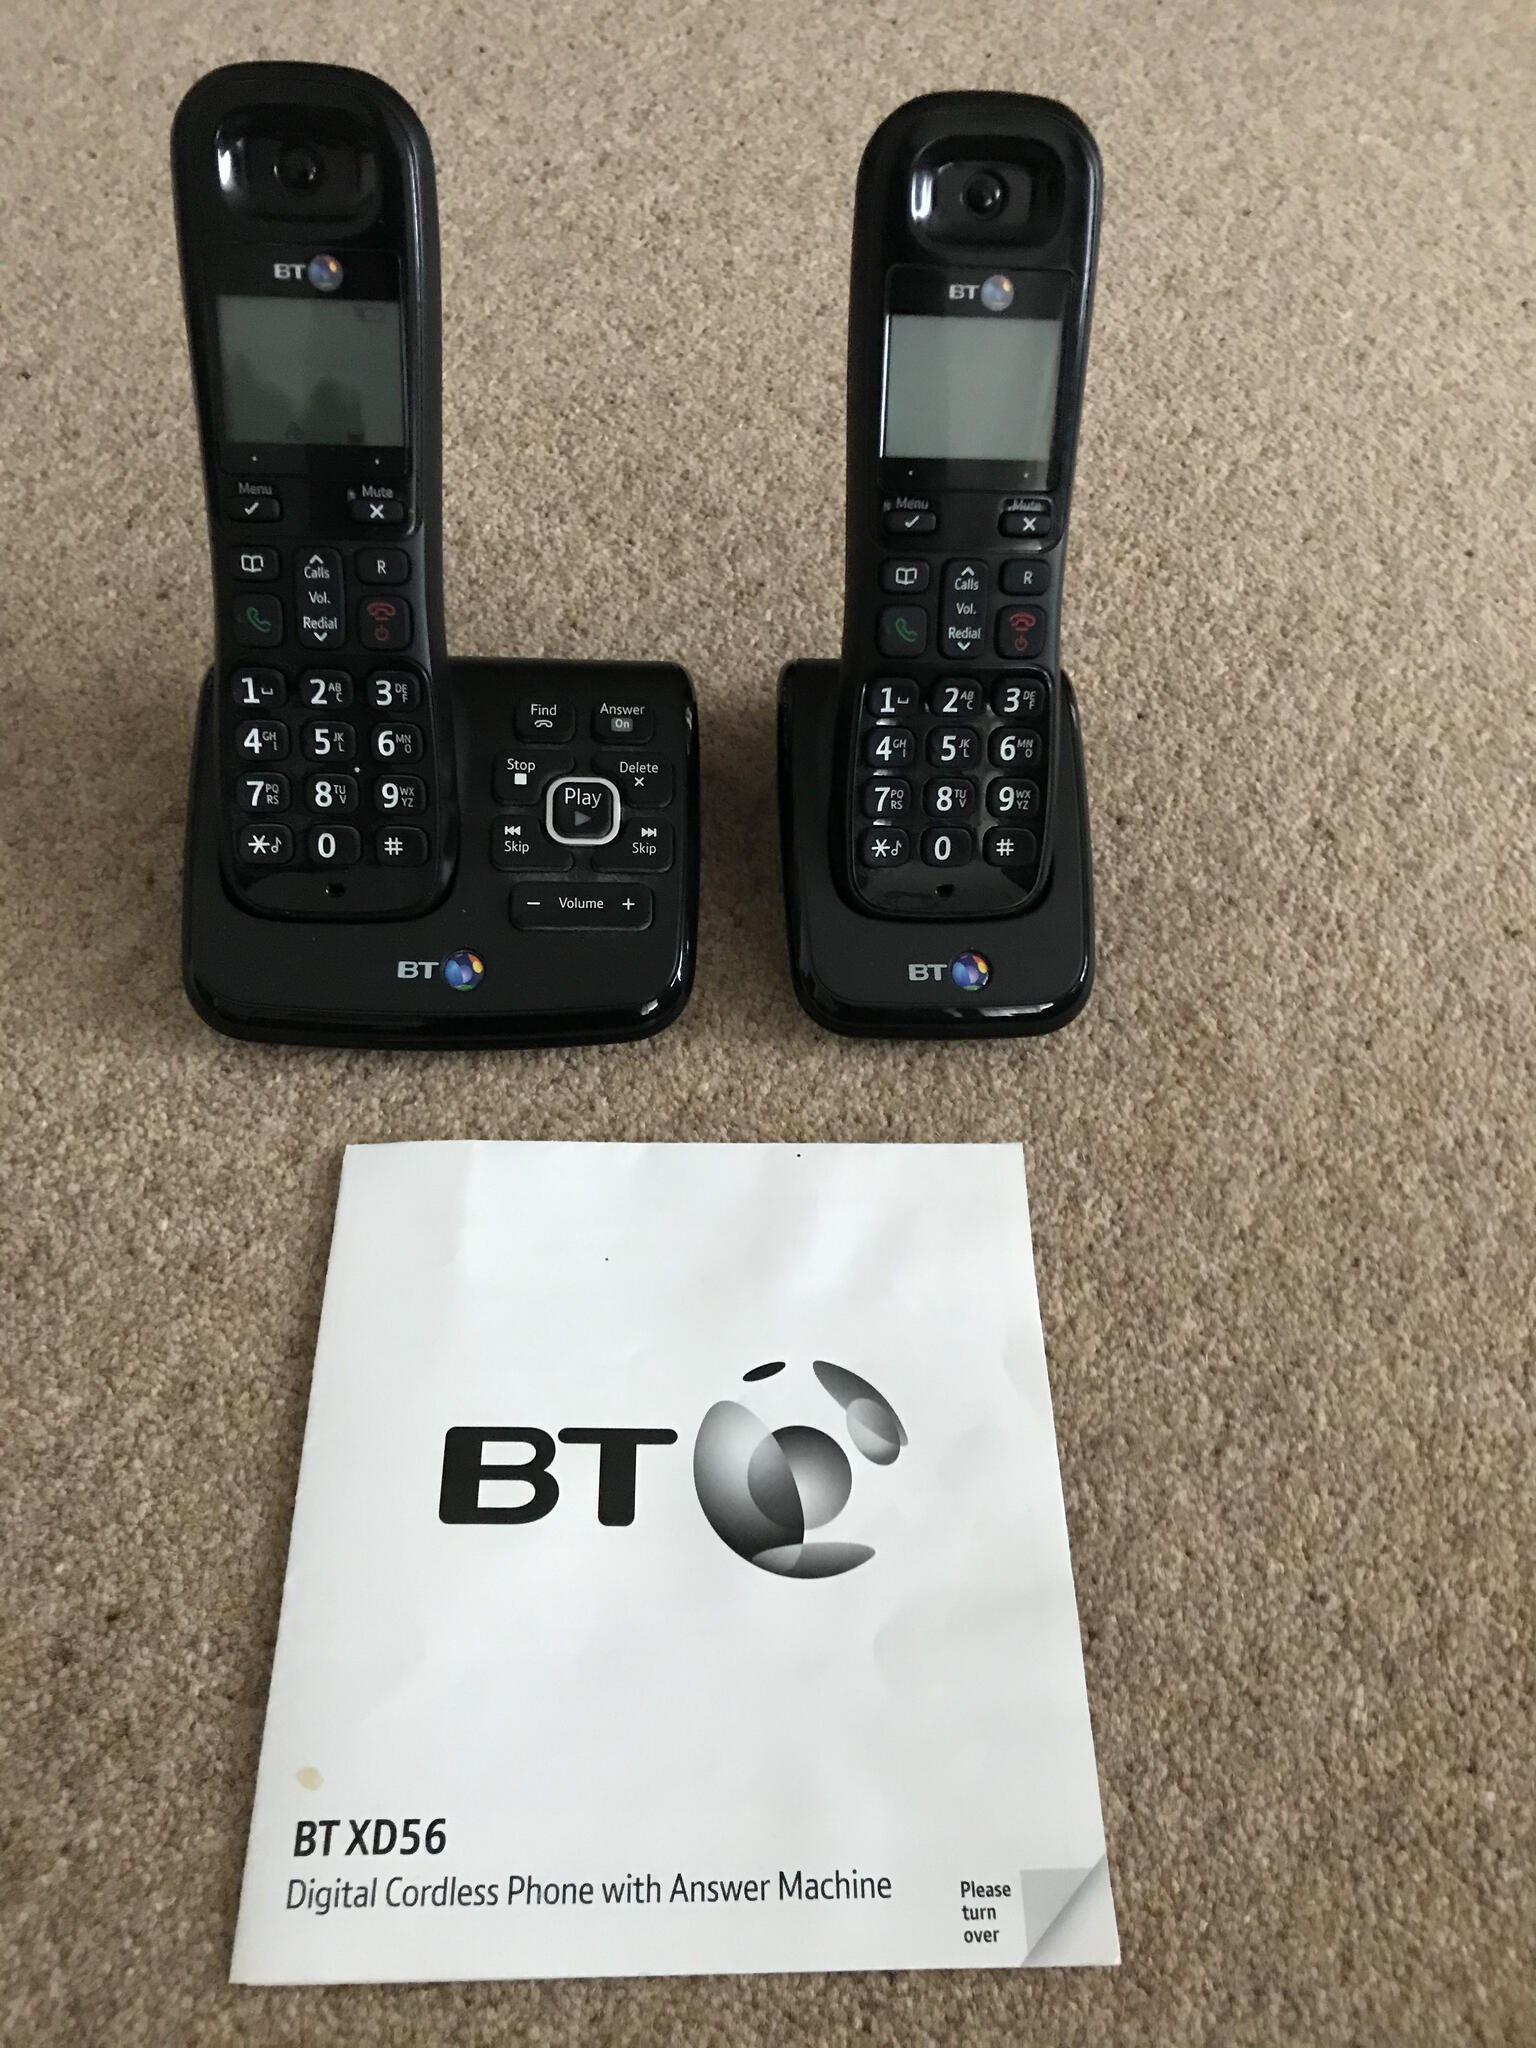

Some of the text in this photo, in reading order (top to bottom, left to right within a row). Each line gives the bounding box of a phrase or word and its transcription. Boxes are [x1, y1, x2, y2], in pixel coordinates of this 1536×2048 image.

[273, 263, 306, 280] BT
[949, 284, 981, 300] BT
[238, 482, 273, 496] Menu
[361, 485, 394, 499] Mute
[895, 497, 929, 510] Menu
[304, 566, 330, 580] Calls
[377, 560, 387, 574] R
[954, 578, 979, 591] Calls
[1023, 571, 1033, 585] R
[308, 591, 331, 604] Vol.
[956, 602, 977, 615] Vol.
[303, 616, 338, 630] Redial
[948, 627, 981, 640] Redial
[241, 677, 261, 704] 1
[310, 678, 328, 705] 2
[375, 680, 393, 706] 3
[600, 703, 645, 715] Answer
[880, 687, 895, 713] 1
[942, 687, 959, 713] 2
[1003, 687, 1021, 713] 3
[531, 703, 558, 716] Find
[614, 718, 630, 729] On
[243, 728, 262, 754] 4
[314, 728, 331, 755] 5
[378, 730, 396, 757] 6
[875, 735, 892, 761] 4
[940, 735, 957, 761] 5
[1000, 735, 1016, 761] 6
[506, 758, 536, 772] Stop
[619, 761, 659, 774] Delete
[246, 781, 265, 807] 7
[314, 781, 333, 808] 8
[381, 782, 399, 809] 9
[565, 787, 602, 808] Play
[874, 787, 891, 812] 7
[936, 786, 953, 812] 8
[999, 786, 1015, 812] 9
[504, 840, 530, 854] Skip
[632, 842, 657, 855] Skip
[558, 896, 604, 909] Volume
[397, 960, 440, 979] BT
[908, 963, 948, 981] BT
[438, 1425, 679, 1527] BT
[293, 1818, 447, 1857] BT XD56
[286, 1869, 892, 1915] Digital Cordless Phone with Answer Machine
[960, 1880, 1012, 1898] Please
[961, 1905, 997, 1921] turn
[963, 1929, 1000, 1944] over
